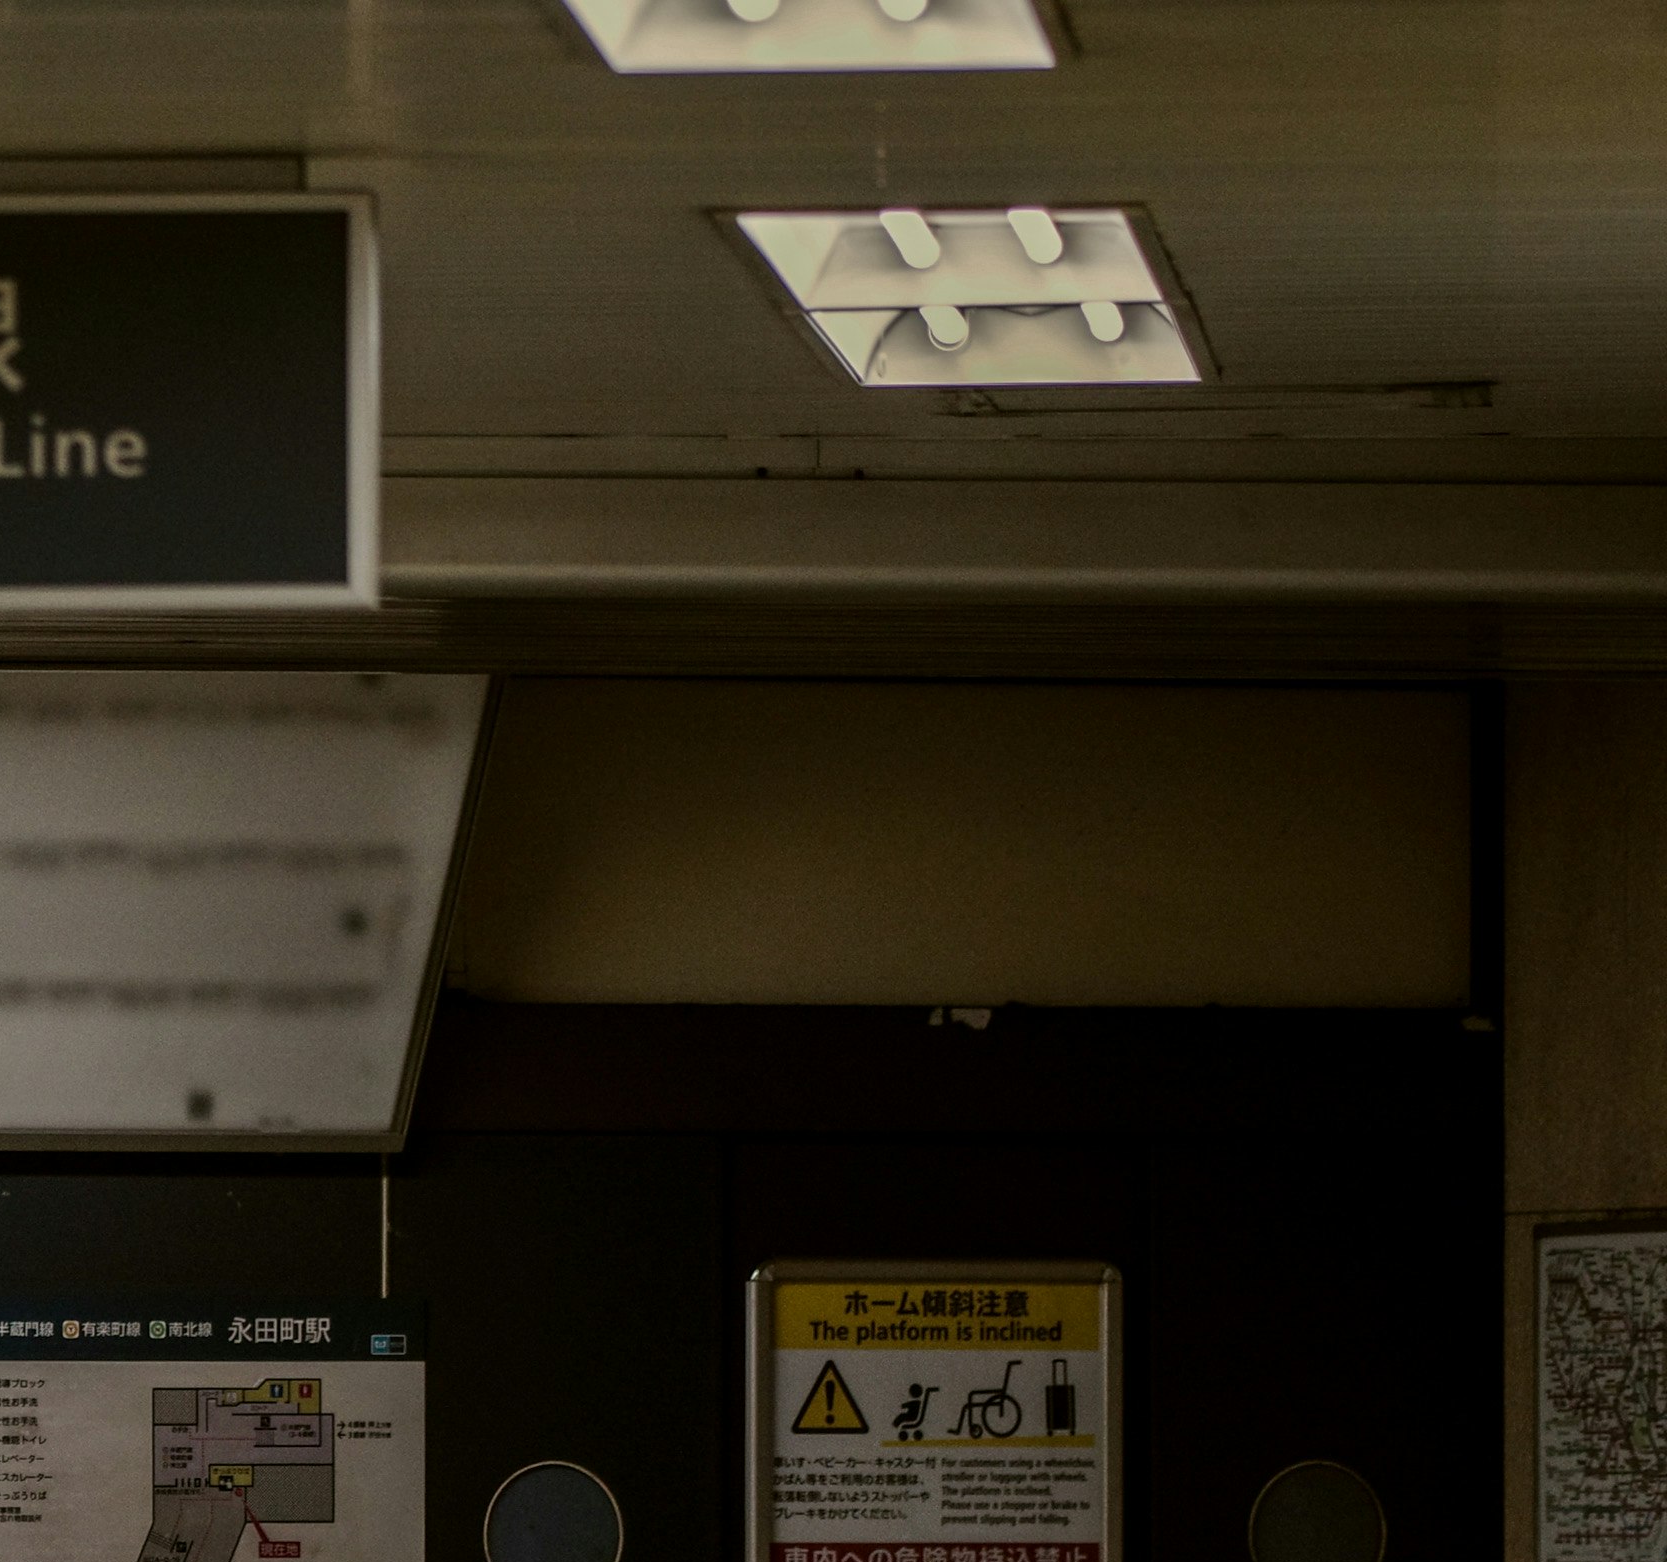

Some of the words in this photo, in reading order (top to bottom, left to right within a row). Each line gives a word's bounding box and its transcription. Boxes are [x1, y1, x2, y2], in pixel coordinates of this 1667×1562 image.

[844, 1290, 1030, 1318] ホーム傾斜注意
[81, 1322, 141, 1339] 有楽町線
[168, 1322, 213, 1338] 南北線
[227, 1316, 332, 1344] 永田町駅
[810, 1321, 849, 1341] The
[857, 1321, 948, 1345] platform
[957, 1322, 972, 1341] is
[979, 1321, 1063, 1342] inclined
